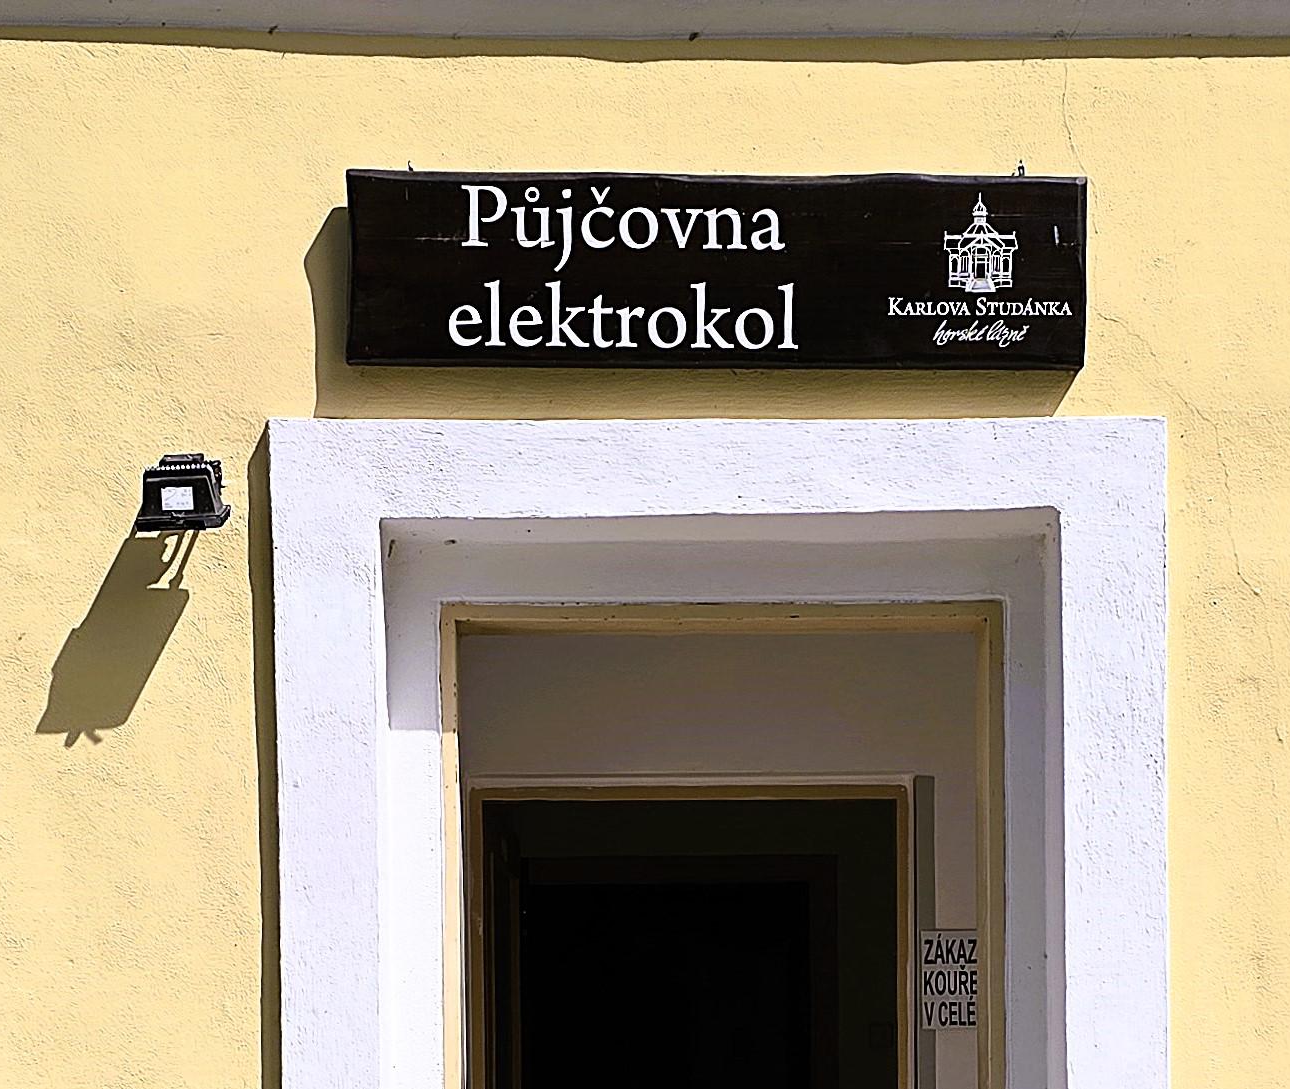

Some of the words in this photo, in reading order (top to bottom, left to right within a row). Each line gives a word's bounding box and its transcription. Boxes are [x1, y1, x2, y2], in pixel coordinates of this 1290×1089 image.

[461, 184, 786, 273] Půjčovna
[448, 280, 799, 350] elektrokol
[887, 296, 972, 316] KARLOVA
[975, 296, 1073, 316] STUDÁNKA
[932, 319, 989, 346] horské
[986, 319, 1030, 348] lázně
[923, 932, 978, 965] ZÁKAZ
[923, 1001, 935, 1027] V
[938, 995, 977, 1027] CELÉ
